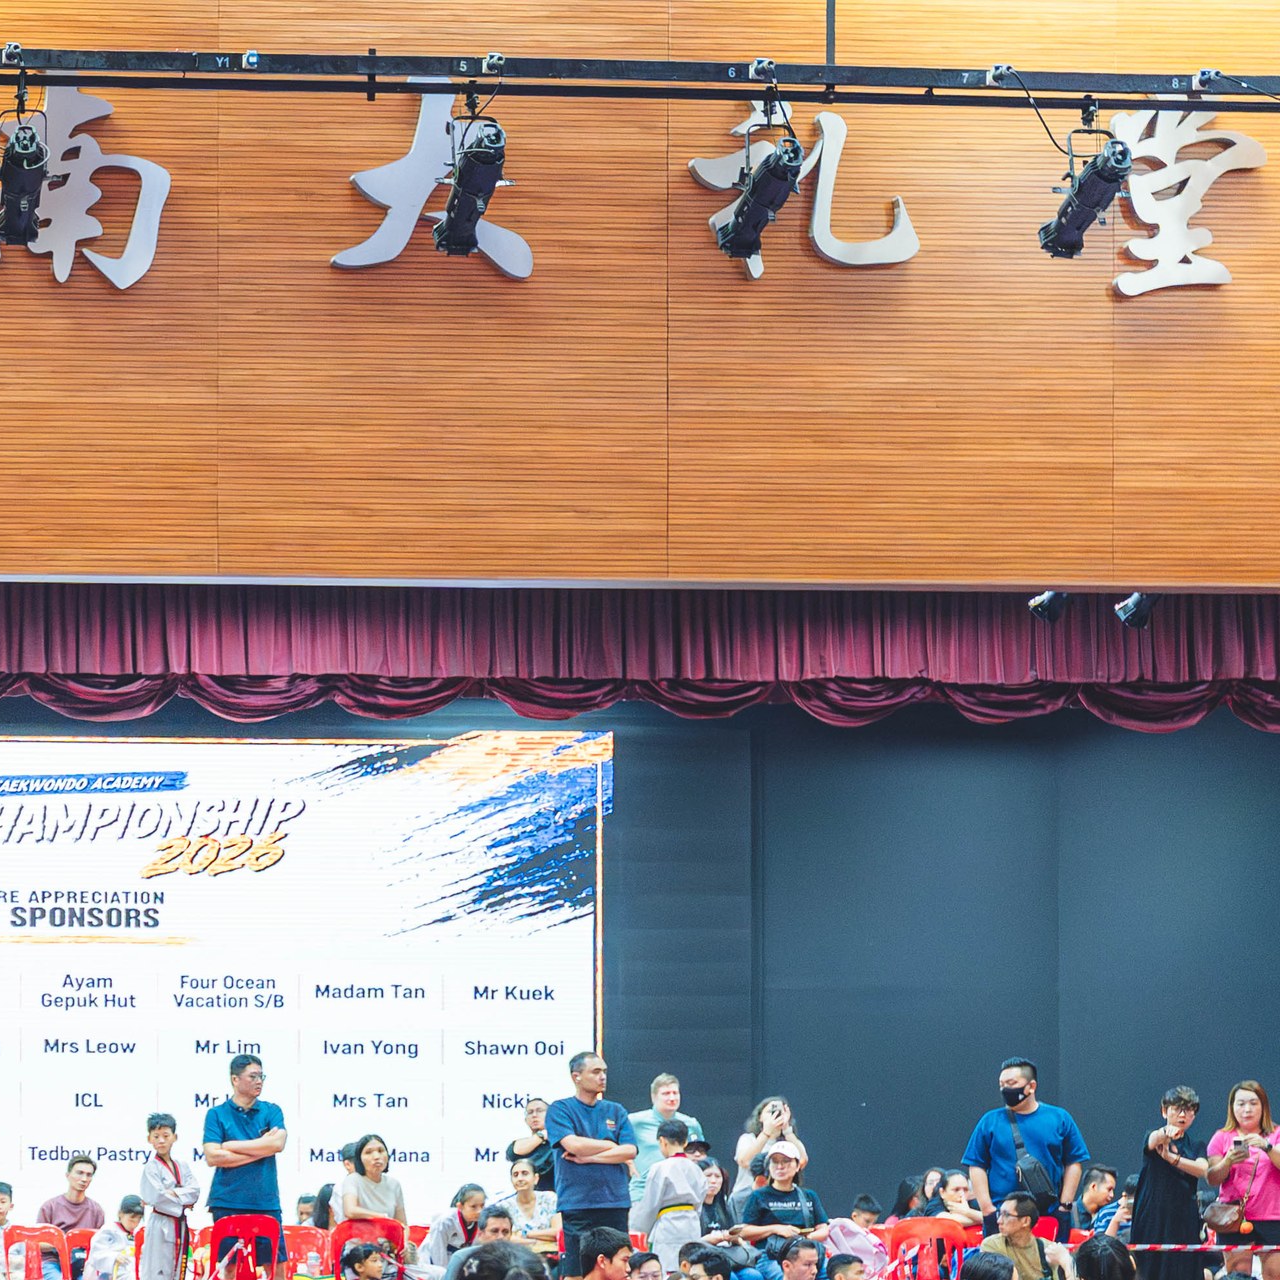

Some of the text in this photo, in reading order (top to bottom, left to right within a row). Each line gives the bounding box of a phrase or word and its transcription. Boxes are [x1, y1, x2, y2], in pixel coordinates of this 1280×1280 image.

[214, 56, 231, 69] Y1
[459, 60, 468, 73] 5
[727, 67, 737, 79] 6
[961, 73, 970, 84] 7
[1171, 78, 1180, 89] 8
[91, 775, 166, 791] ACADEMY
[140, 832, 289, 879] 2026
[28, 889, 166, 905] APPRECIATION
[9, 906, 160, 928] SPONSORS
[62, 974, 113, 992] Ayam
[180, 975, 276, 990] Four Ocean
[315, 984, 426, 1000] Madam Tan
[473, 985, 556, 1001] Mr Kuek
[41, 993, 137, 1011] Gepuk Hut
[173, 993, 285, 1009] Vacation S/B
[43, 1038, 136, 1054] Mrs Leow
[195, 1039, 261, 1055] Mr Lim
[323, 1040, 419, 1059] Ivan Yong
[464, 1040, 565, 1056] Shawn Ooi
[74, 1093, 103, 1108] ICL
[333, 1093, 408, 1109] Mrs Tan
[482, 1093, 532, 1109] Nicki
[96, 1147, 152, 1165] Pastry
[475, 1148, 499, 1162] Mr
